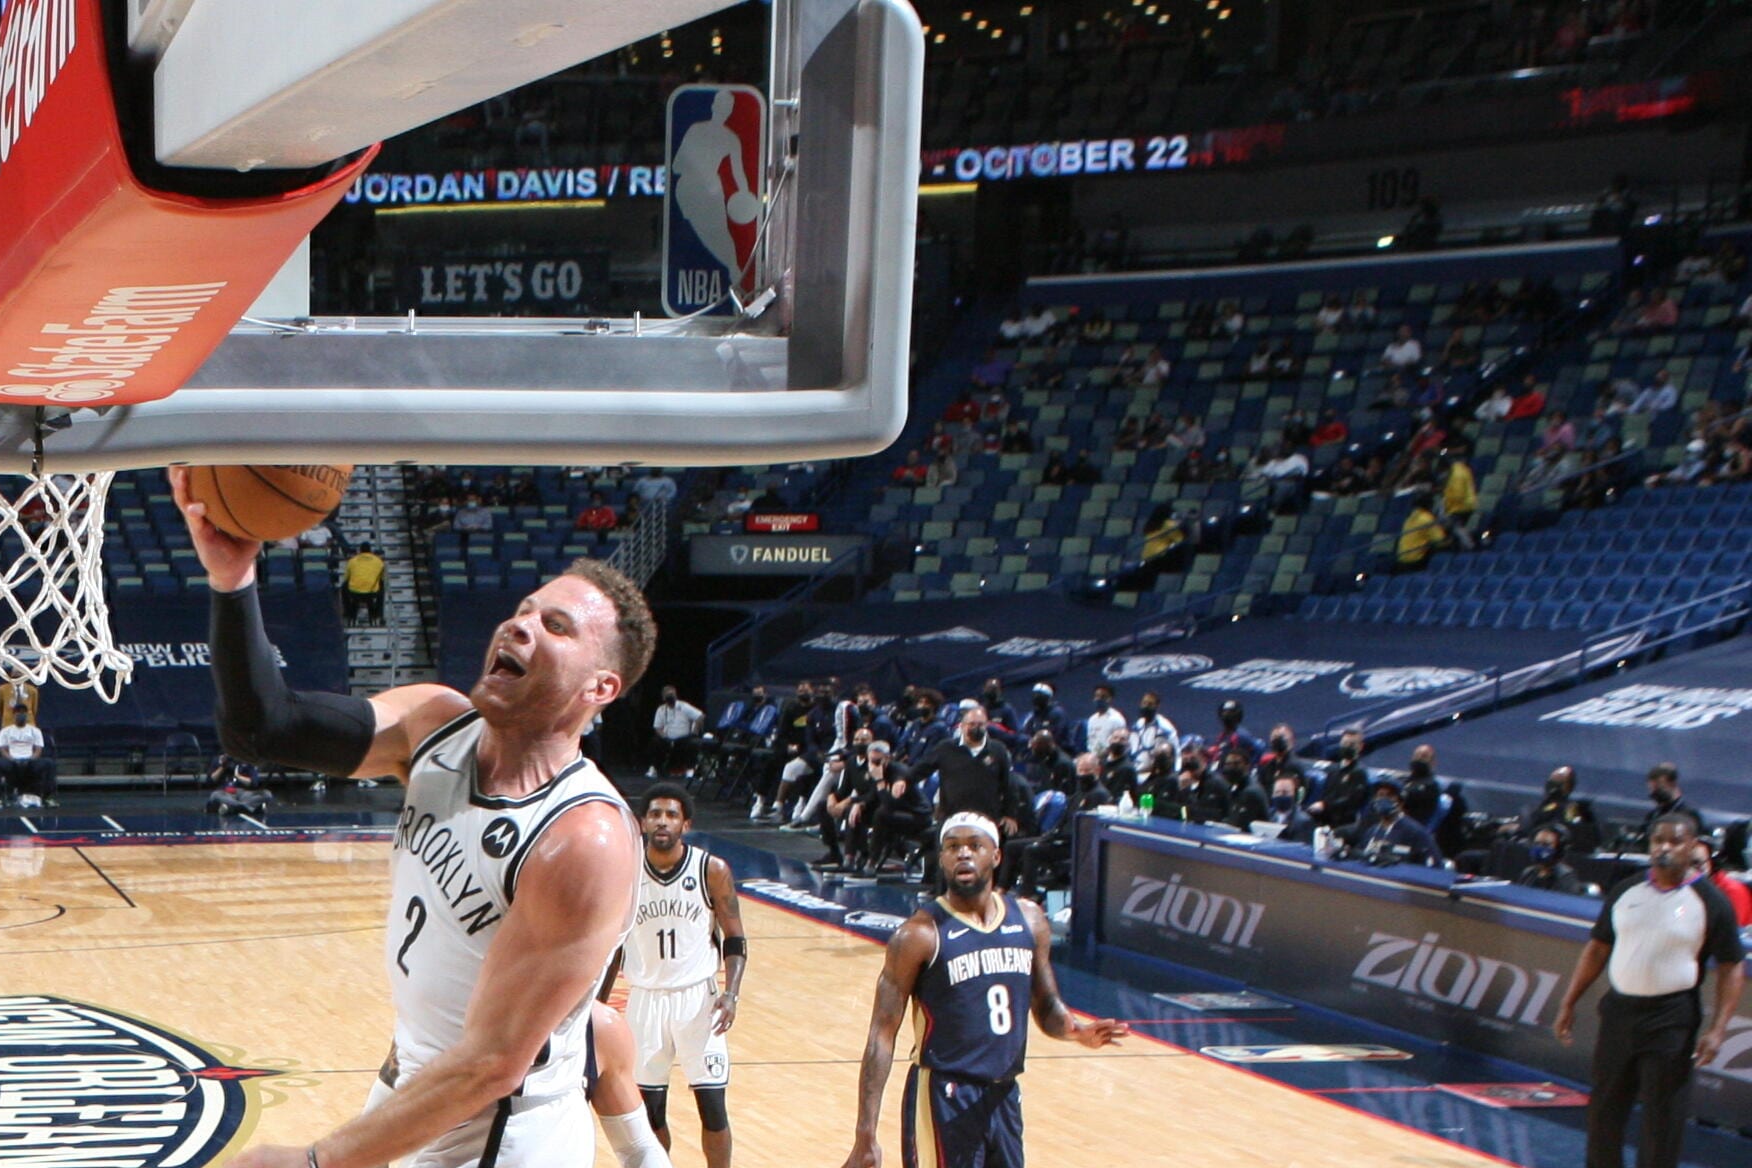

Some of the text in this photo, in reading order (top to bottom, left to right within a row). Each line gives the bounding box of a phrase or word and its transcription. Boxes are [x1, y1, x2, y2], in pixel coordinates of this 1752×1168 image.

[955, 140, 1135, 181] OCTOBER
[1145, 136, 1189, 169] 22
[345, 172, 485, 204] JORDAN
[497, 168, 598, 200] DAVIS
[420, 260, 583, 304] LET'S GO
[677, 269, 721, 306] NBA
[752, 547, 832, 563] FANDUEL
[118, 643, 171, 654] NEW
[636, 898, 702, 926] BROOKLYN
[396, 895, 427, 979] 2
[656, 928, 676, 960] 11
[947, 947, 1033, 986] NEW ORLEANS
[987, 984, 1012, 1035] 8
